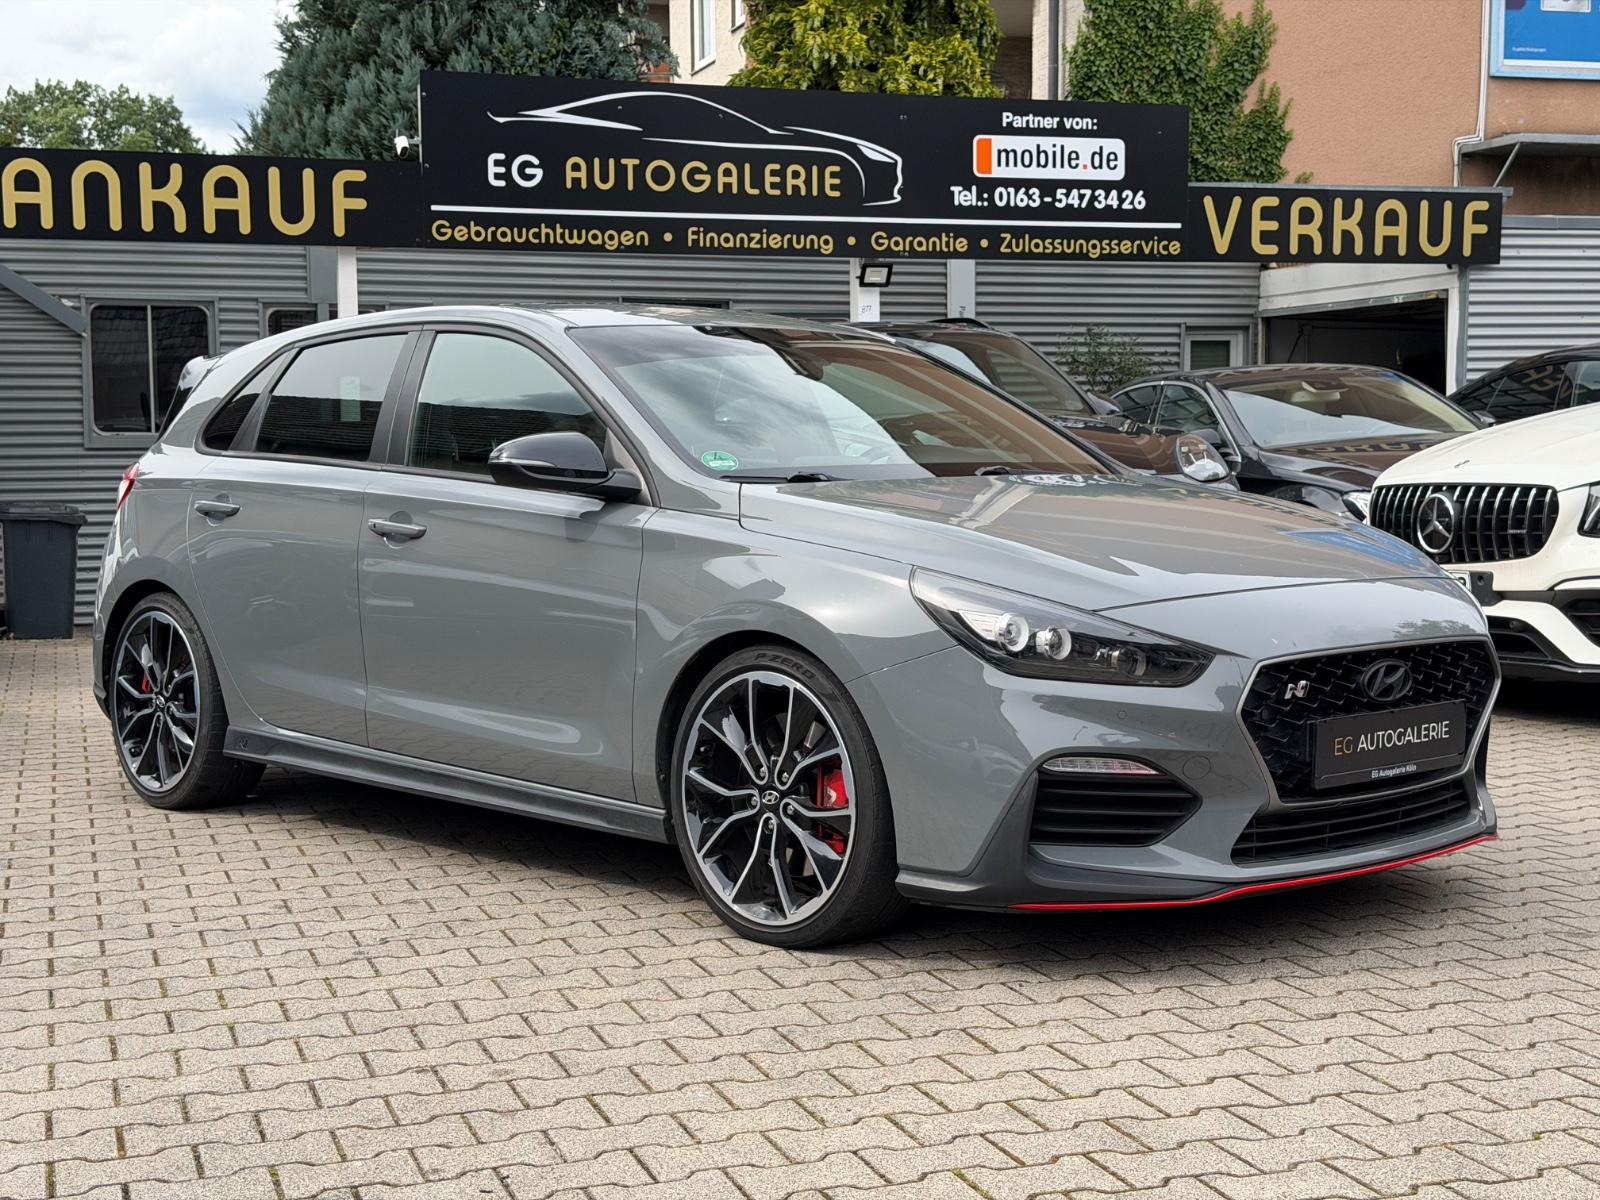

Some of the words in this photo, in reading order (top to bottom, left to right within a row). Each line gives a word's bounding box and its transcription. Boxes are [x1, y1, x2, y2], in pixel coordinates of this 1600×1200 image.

[1002, 112, 1060, 129] Partner
[1063, 116, 1098, 130] von:
[997, 143, 1118, 171] mobile.de
[487, 153, 544, 188] EG
[565, 156, 841, 198] AUTOGALERIE
[2, 158, 367, 237] ANKAUF
[950, 185, 989, 207] Tel.:
[431, 219, 649, 250] Gebrauchtwagen
[688, 227, 834, 255] Finanzierung
[871, 231, 969, 253] Garantie
[1000, 233, 1181, 259] Zulassungsservice
[1203, 195, 1490, 257] VERKAUF
[767, 654, 817, 680] ZERO
[1334, 737, 1353, 756] EG
[1357, 720, 1450, 753] AUTOGALERIE
[1371, 770, 1379, 778] EG
[1379, 766, 1406, 777] Autogalerie
[1406, 764, 1417, 772] Köln
